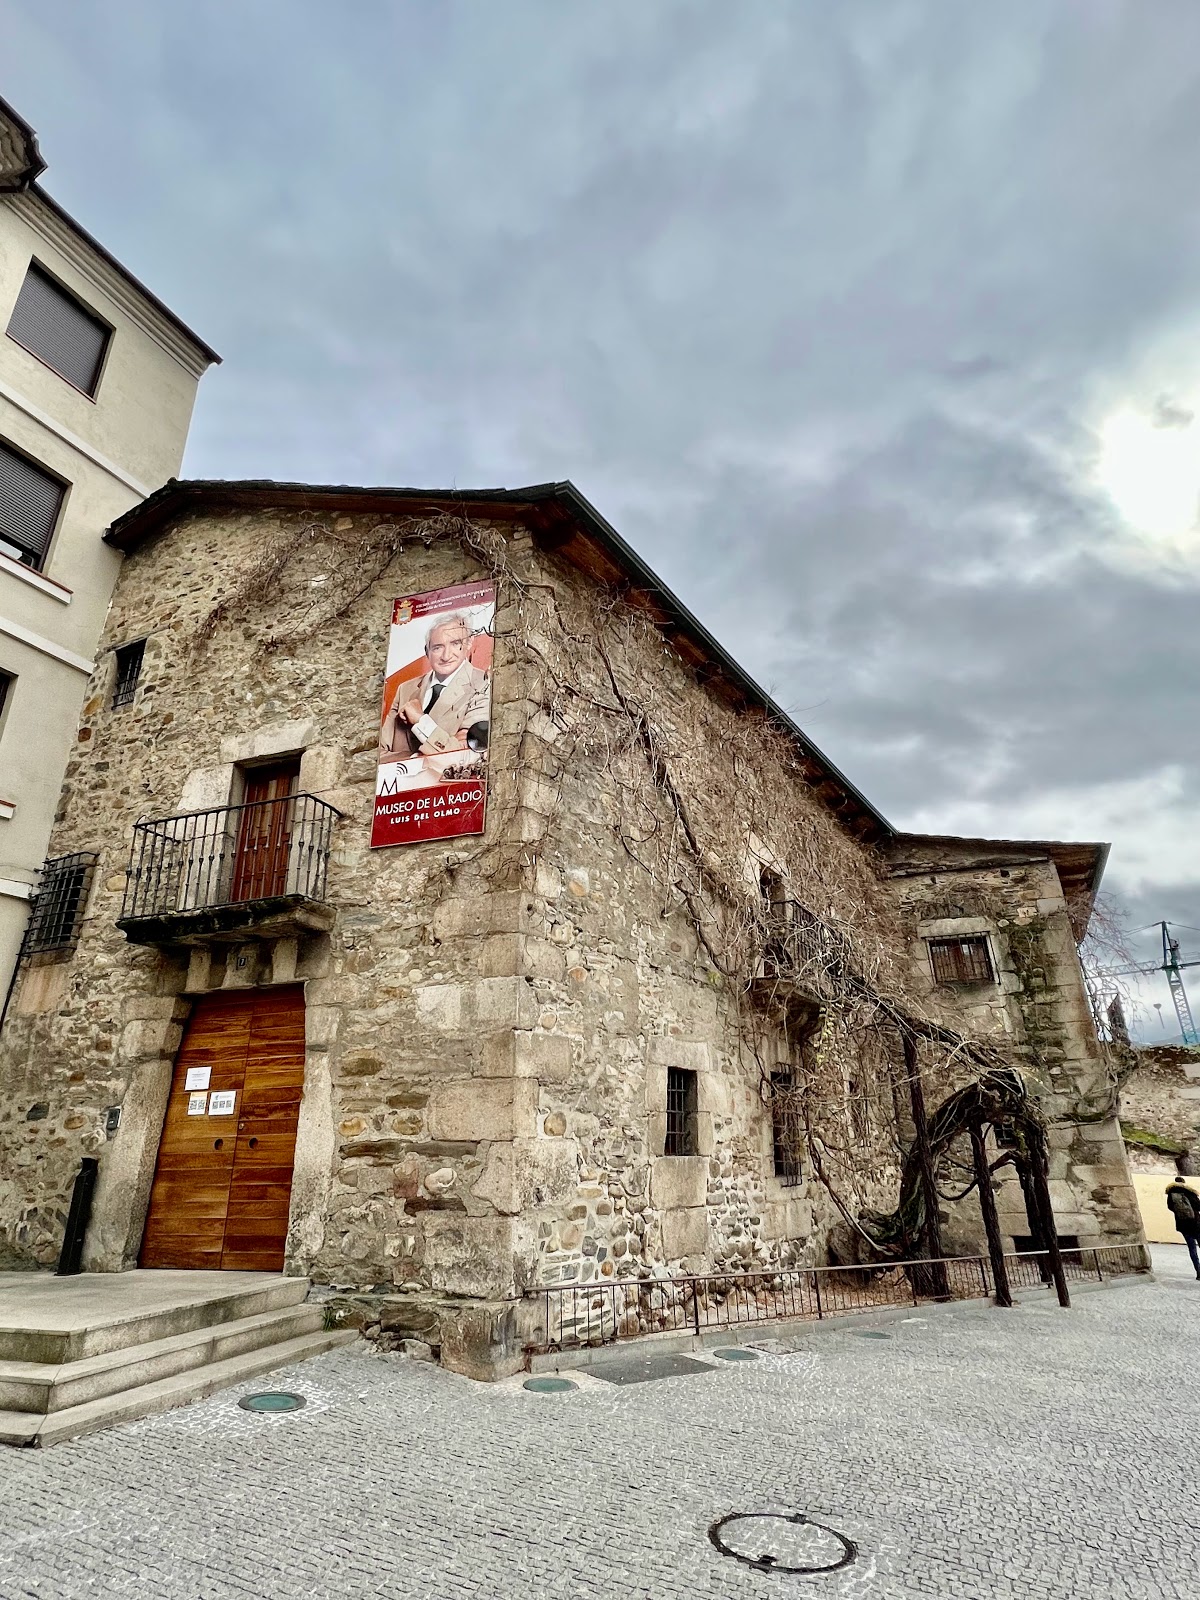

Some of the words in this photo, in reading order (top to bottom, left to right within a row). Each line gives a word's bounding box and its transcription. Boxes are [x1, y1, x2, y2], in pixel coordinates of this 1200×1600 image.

[380, 777, 398, 796] M
[376, 801, 414, 816] MUSEO
[416, 798, 430, 810] DE
[433, 796, 445, 807] LA
[448, 790, 482, 805] RADIO
[390, 816, 410, 824] LUIS
[414, 812, 430, 821] DEL
[433, 808, 460, 818] OLMO
